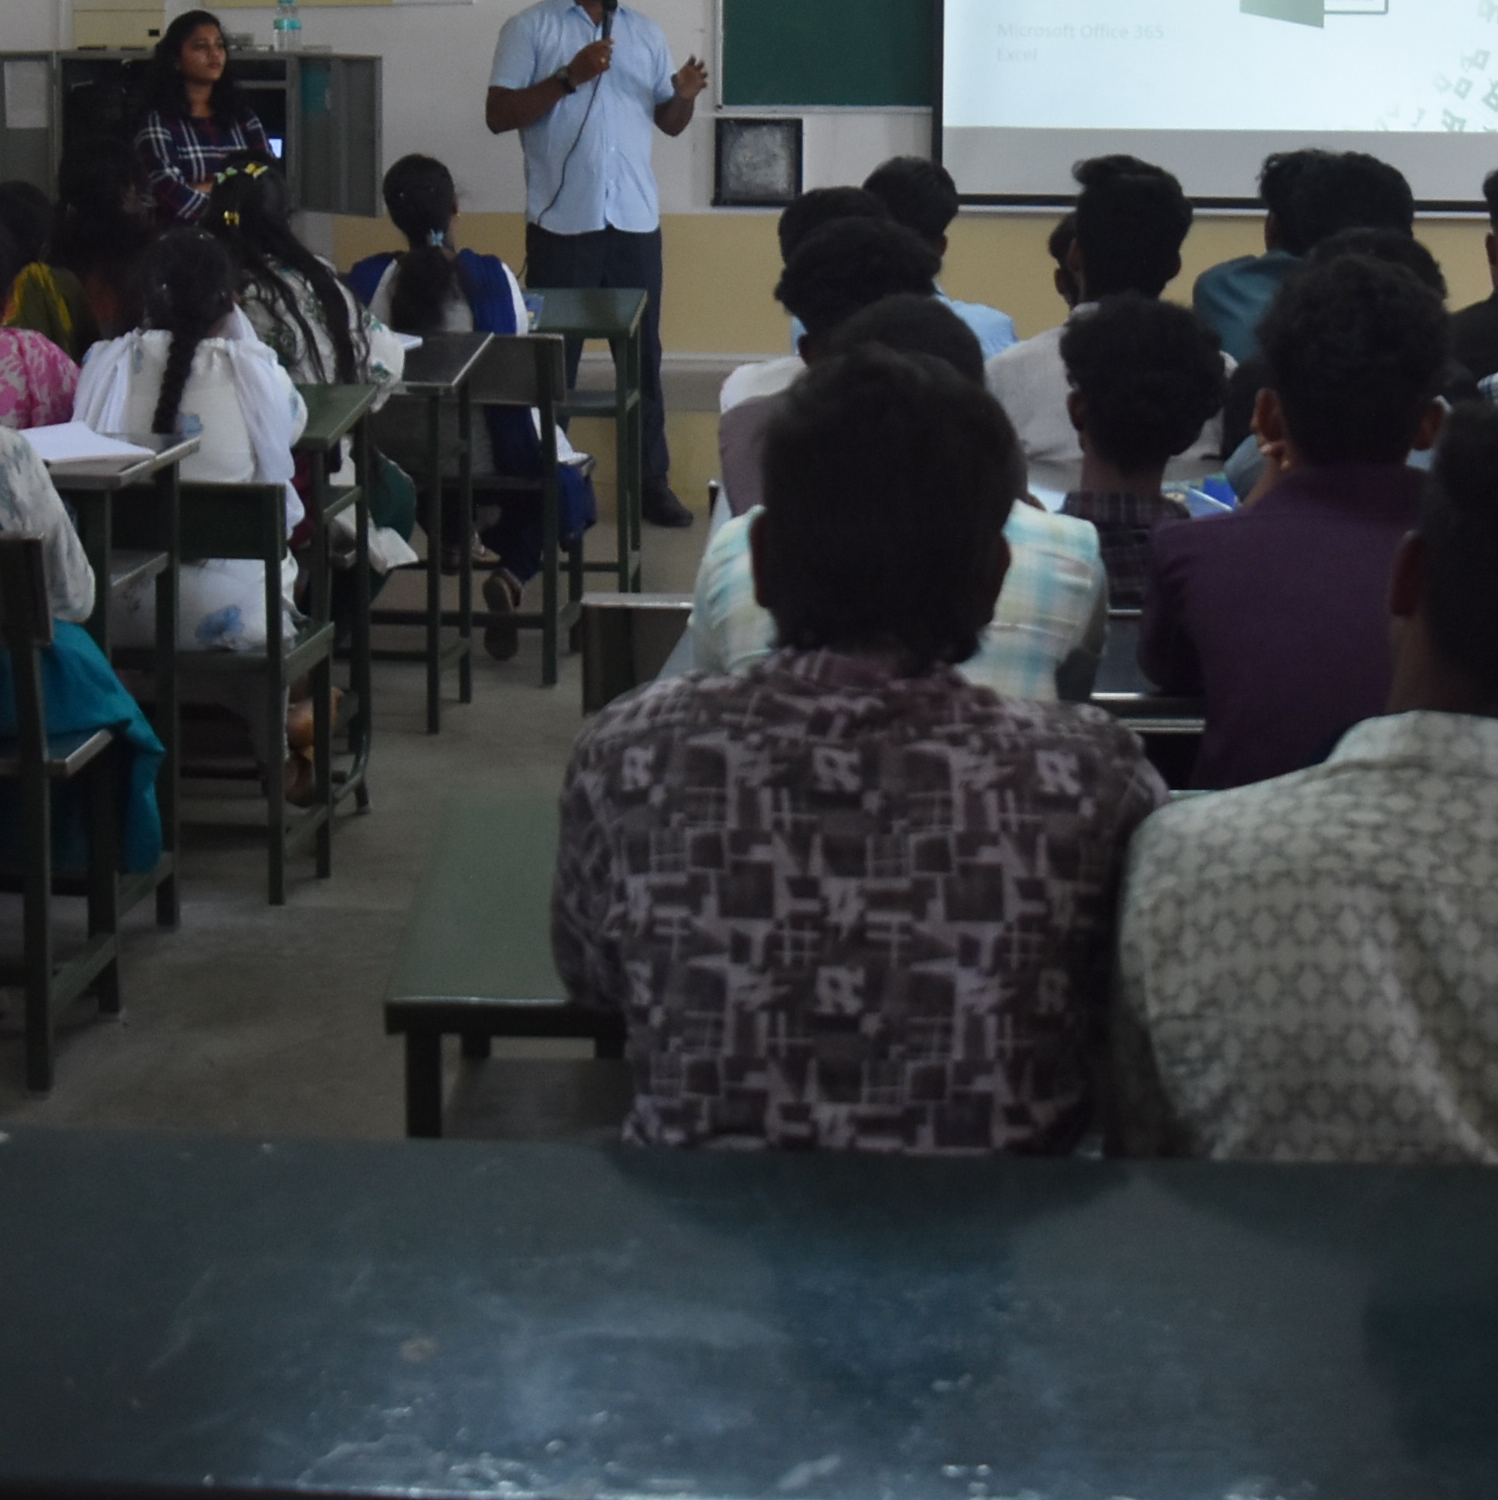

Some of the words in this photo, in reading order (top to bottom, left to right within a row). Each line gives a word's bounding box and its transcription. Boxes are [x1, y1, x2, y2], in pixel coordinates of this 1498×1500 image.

[996, 22, 1076, 40] Microsoft
[1079, 23, 1130, 40] Office
[1134, 24, 1165, 40] 365
[996, 46, 1038, 62] Excel
